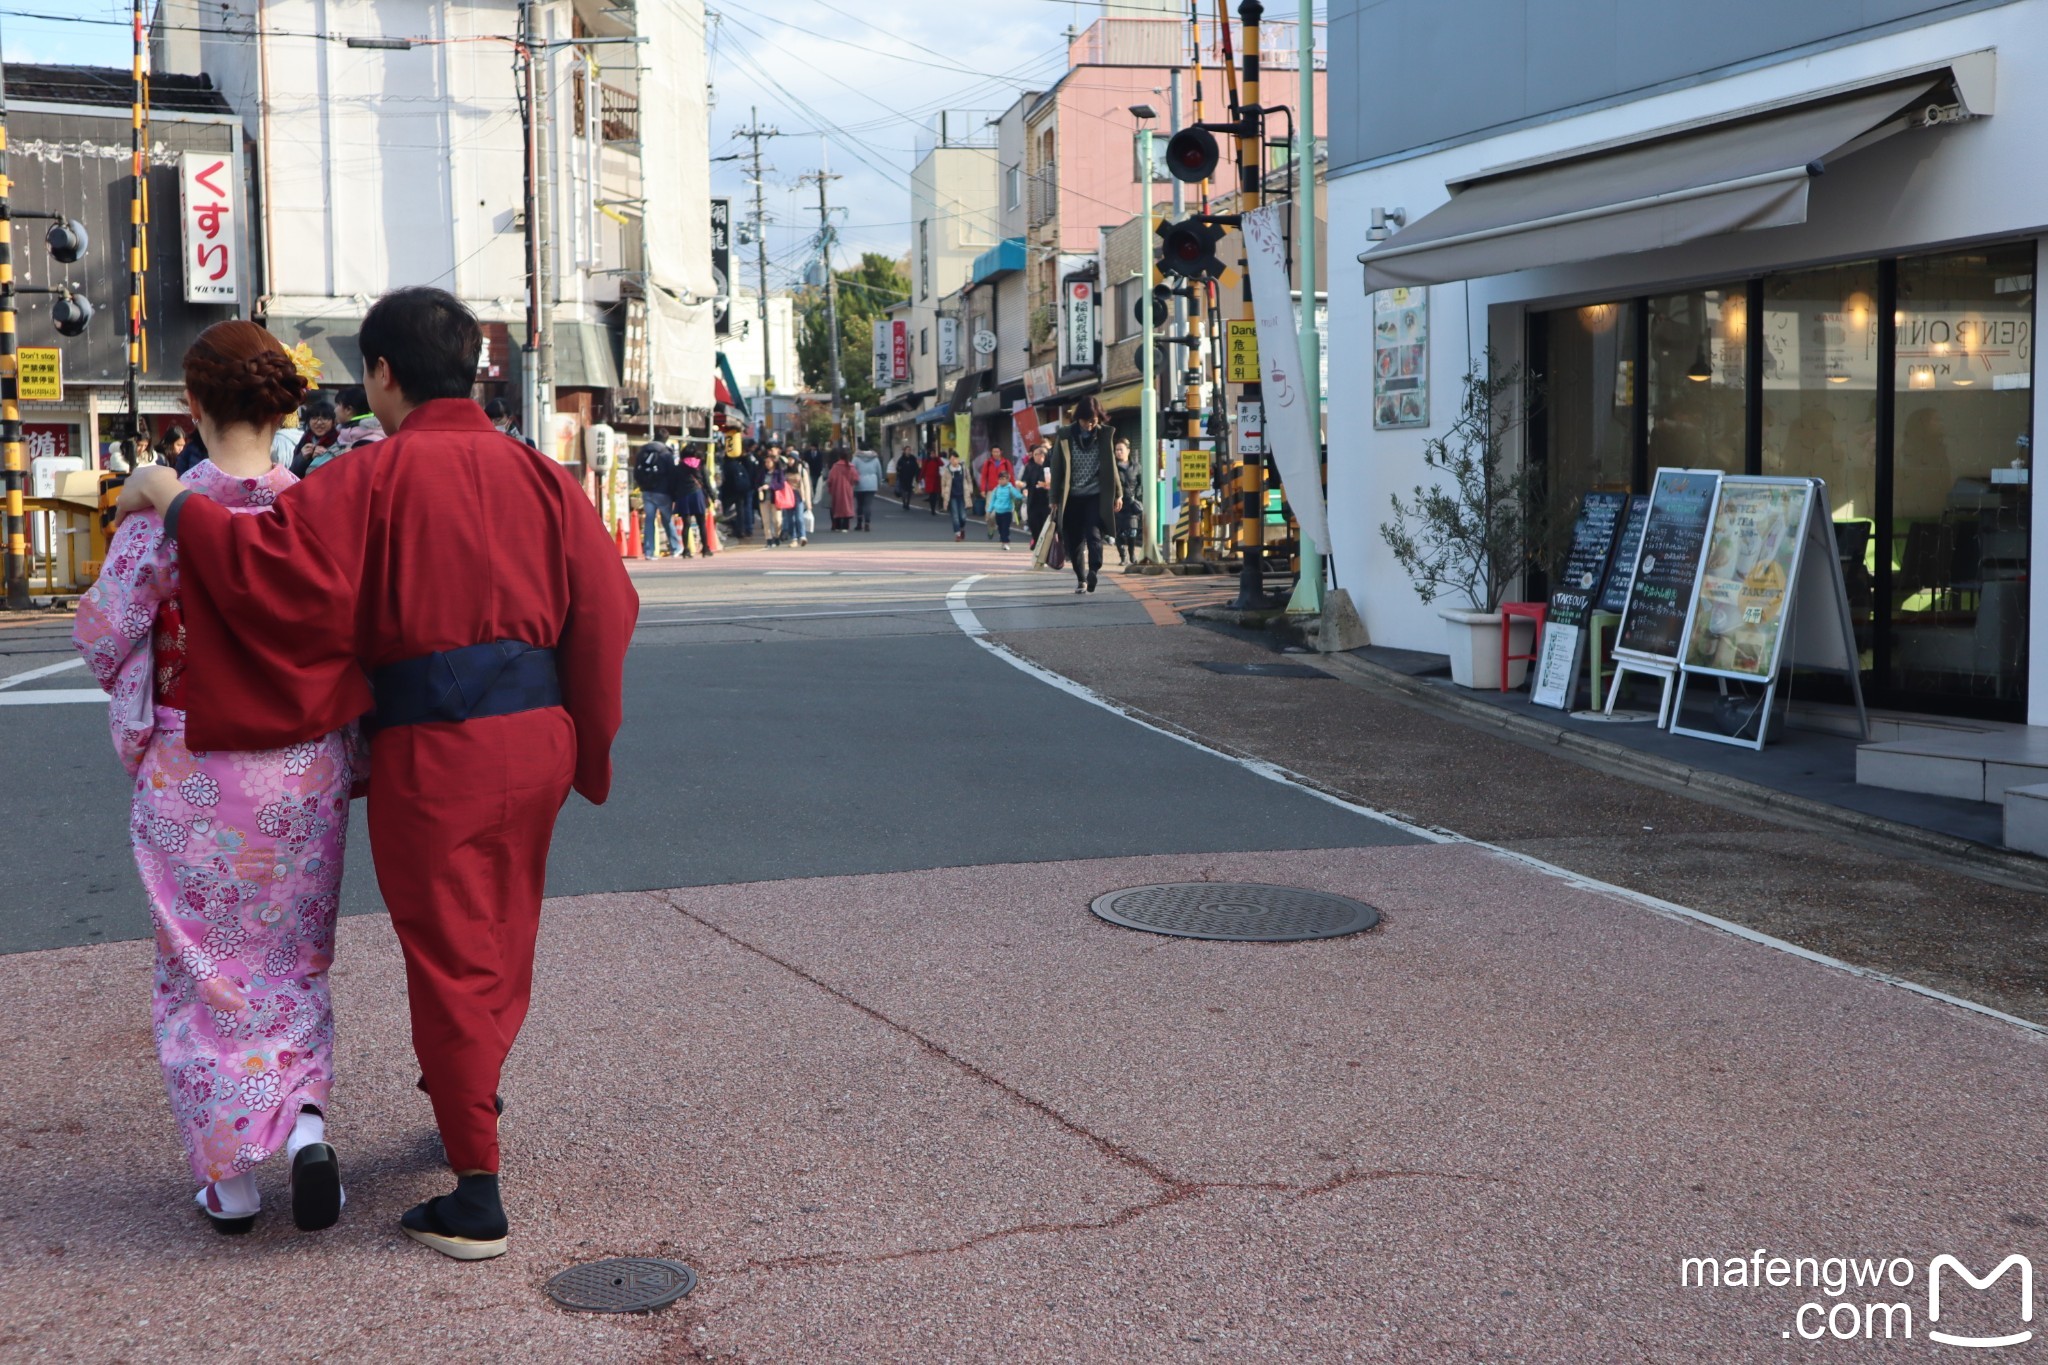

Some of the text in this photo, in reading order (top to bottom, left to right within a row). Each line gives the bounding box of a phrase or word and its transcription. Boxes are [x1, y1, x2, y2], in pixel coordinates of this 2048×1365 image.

[193, 161, 229, 281] くすり
[20, 352, 56, 361] Don't stop
[895, 335, 905, 376] あかね屋
[944, 340, 953, 363] フルタ
[1556, 592, 1587, 605] TAKEOUT
